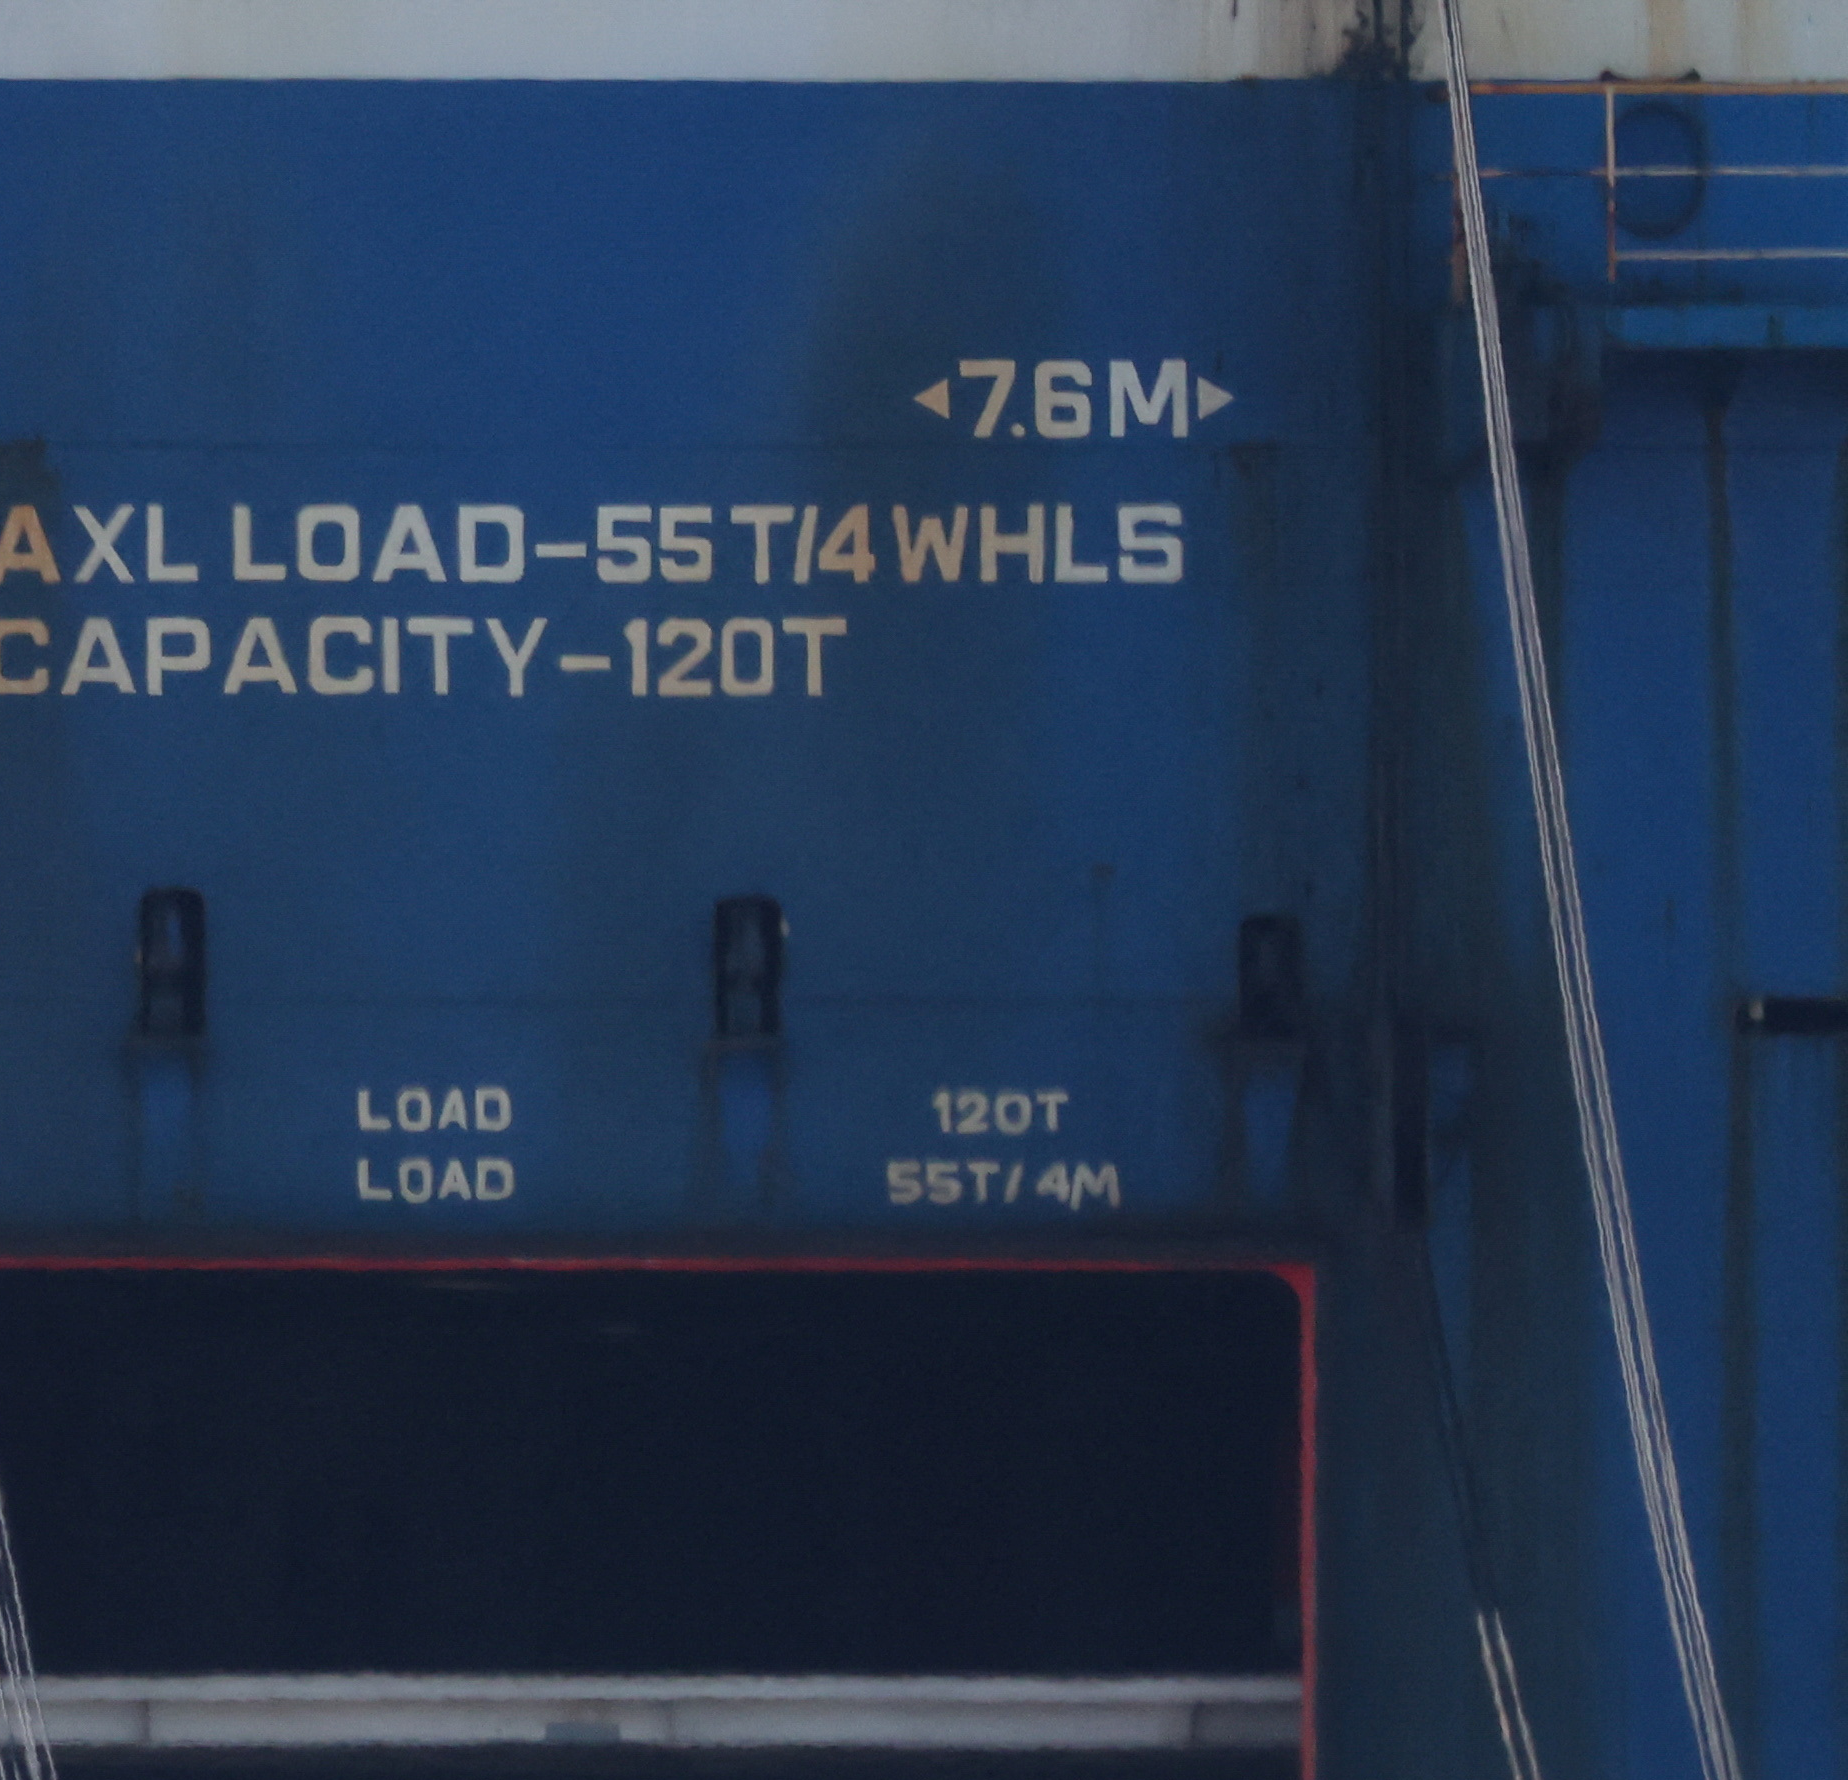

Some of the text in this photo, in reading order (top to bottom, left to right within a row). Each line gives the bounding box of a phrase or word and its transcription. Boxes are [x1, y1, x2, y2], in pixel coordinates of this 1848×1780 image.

[958, 357, 1189, 439] 7.6M
[357, 1085, 513, 1133] LOAD
[932, 1087, 1070, 1136] 120T
[357, 1157, 516, 1204] LOAD
